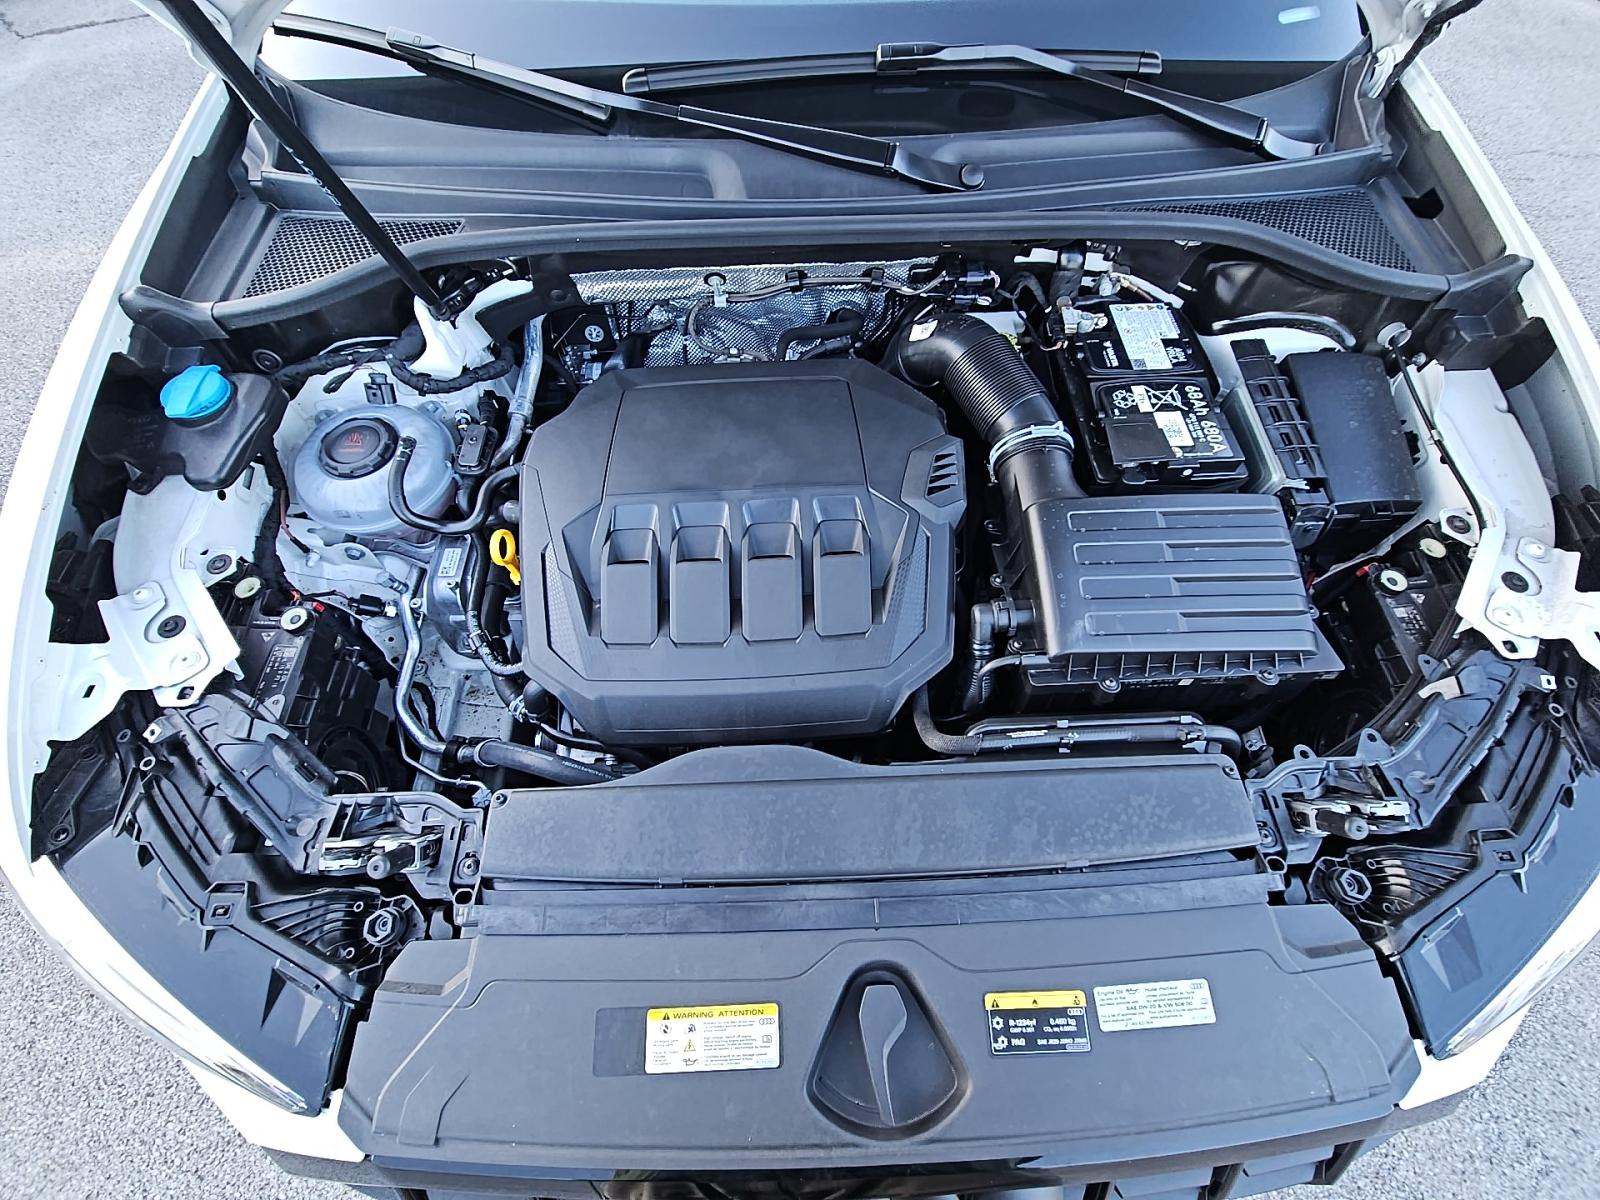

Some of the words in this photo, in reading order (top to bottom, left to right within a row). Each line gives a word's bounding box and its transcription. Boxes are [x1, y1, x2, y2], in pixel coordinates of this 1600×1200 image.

[1200, 420, 1228, 455] 680A
[672, 1011, 714, 1019] WARNING
[718, 1008, 764, 1017] ATTENTION
